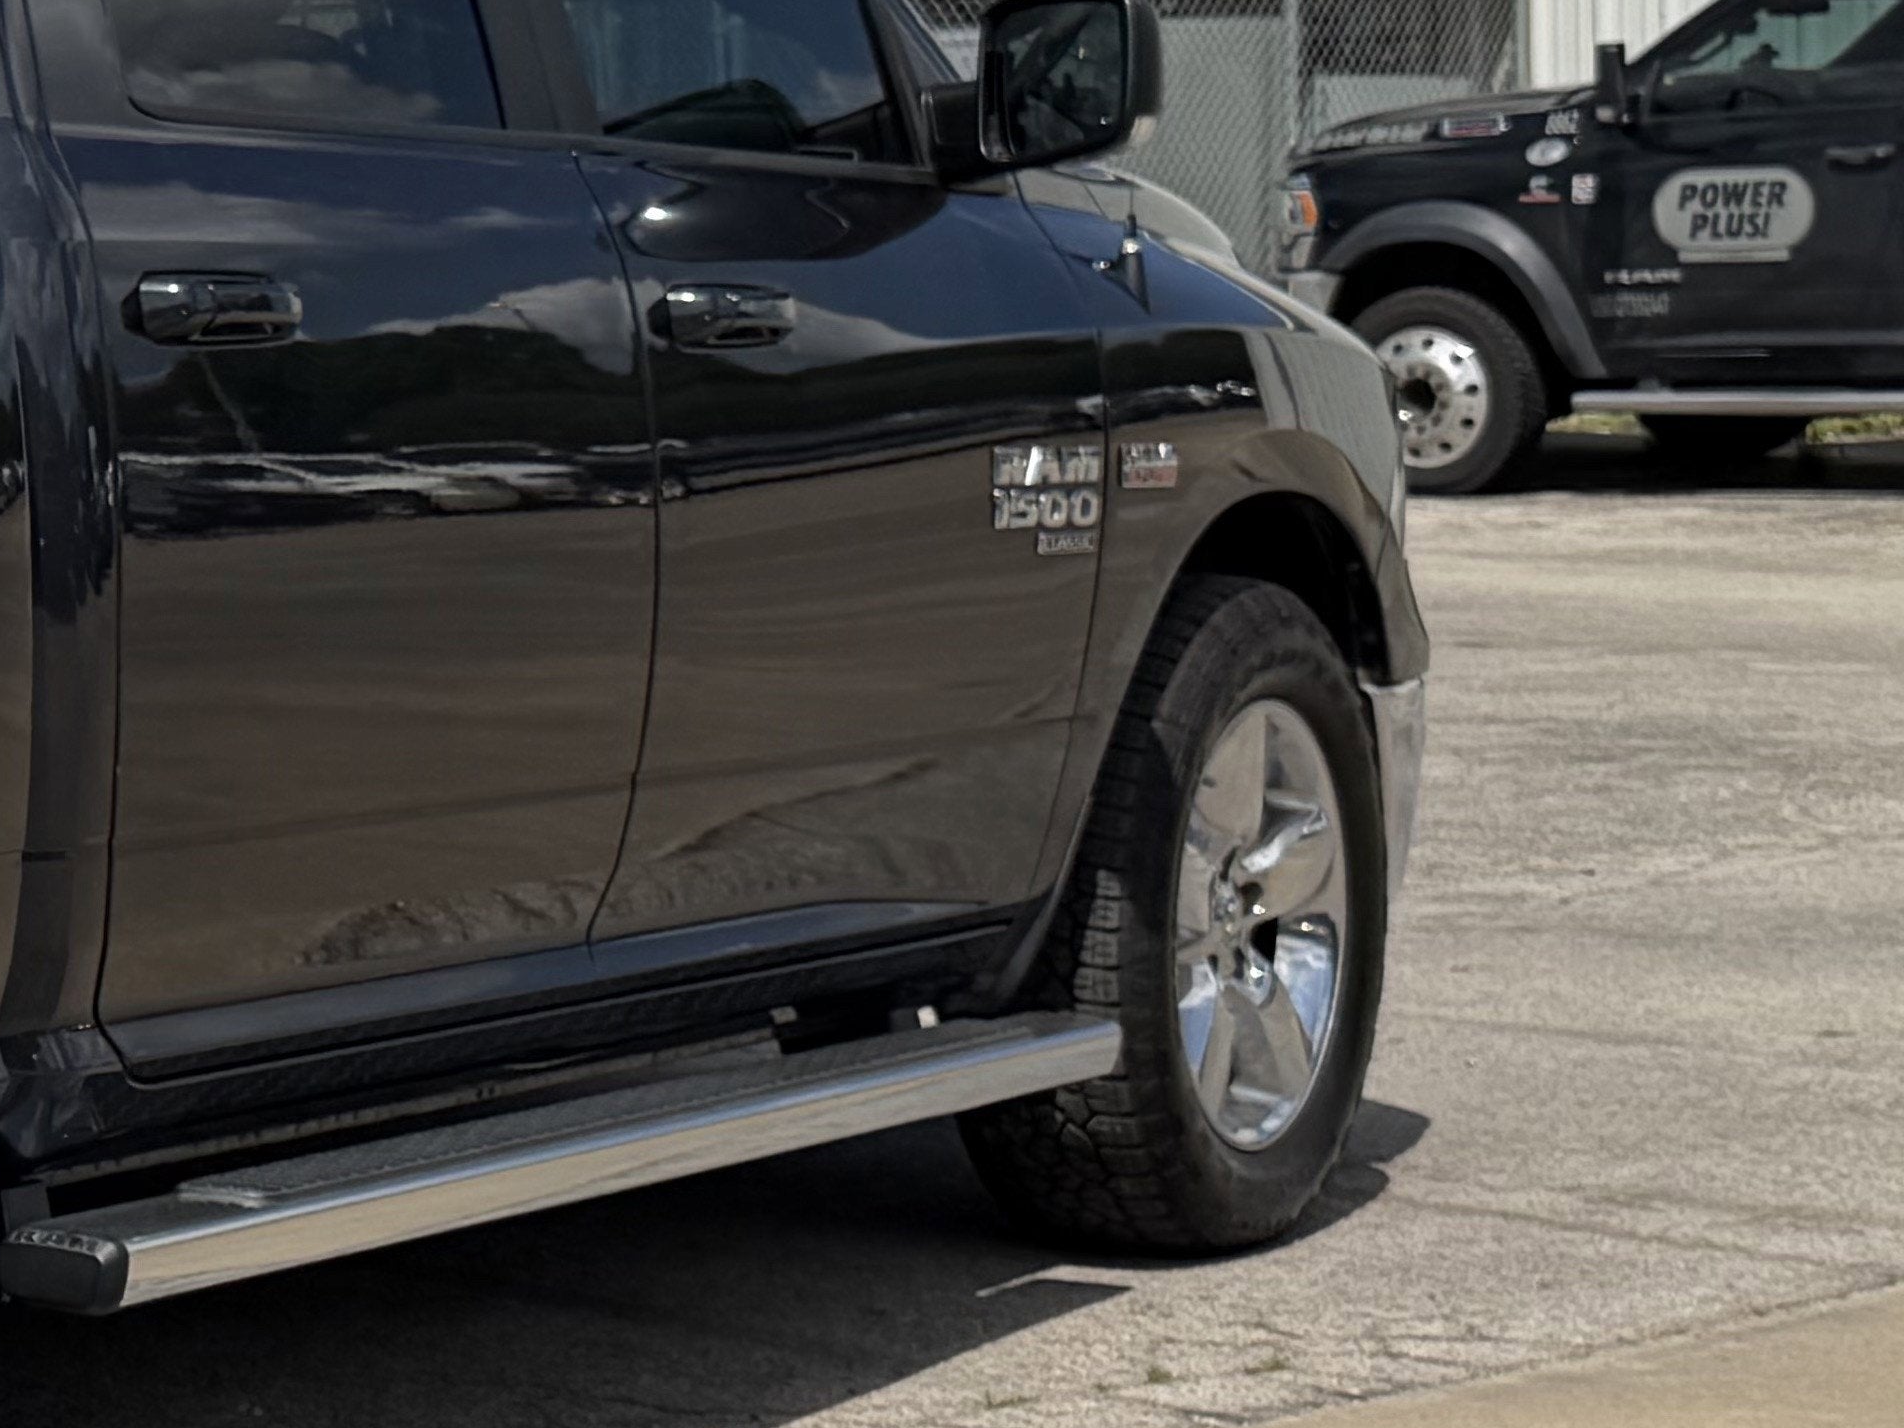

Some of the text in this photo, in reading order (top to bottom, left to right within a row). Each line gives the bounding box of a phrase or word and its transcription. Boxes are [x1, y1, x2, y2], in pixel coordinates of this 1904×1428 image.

[1677, 180, 1788, 211] POWER
[1689, 211, 1772, 240] PLUS!
[993, 487, 1099, 530] 1500
